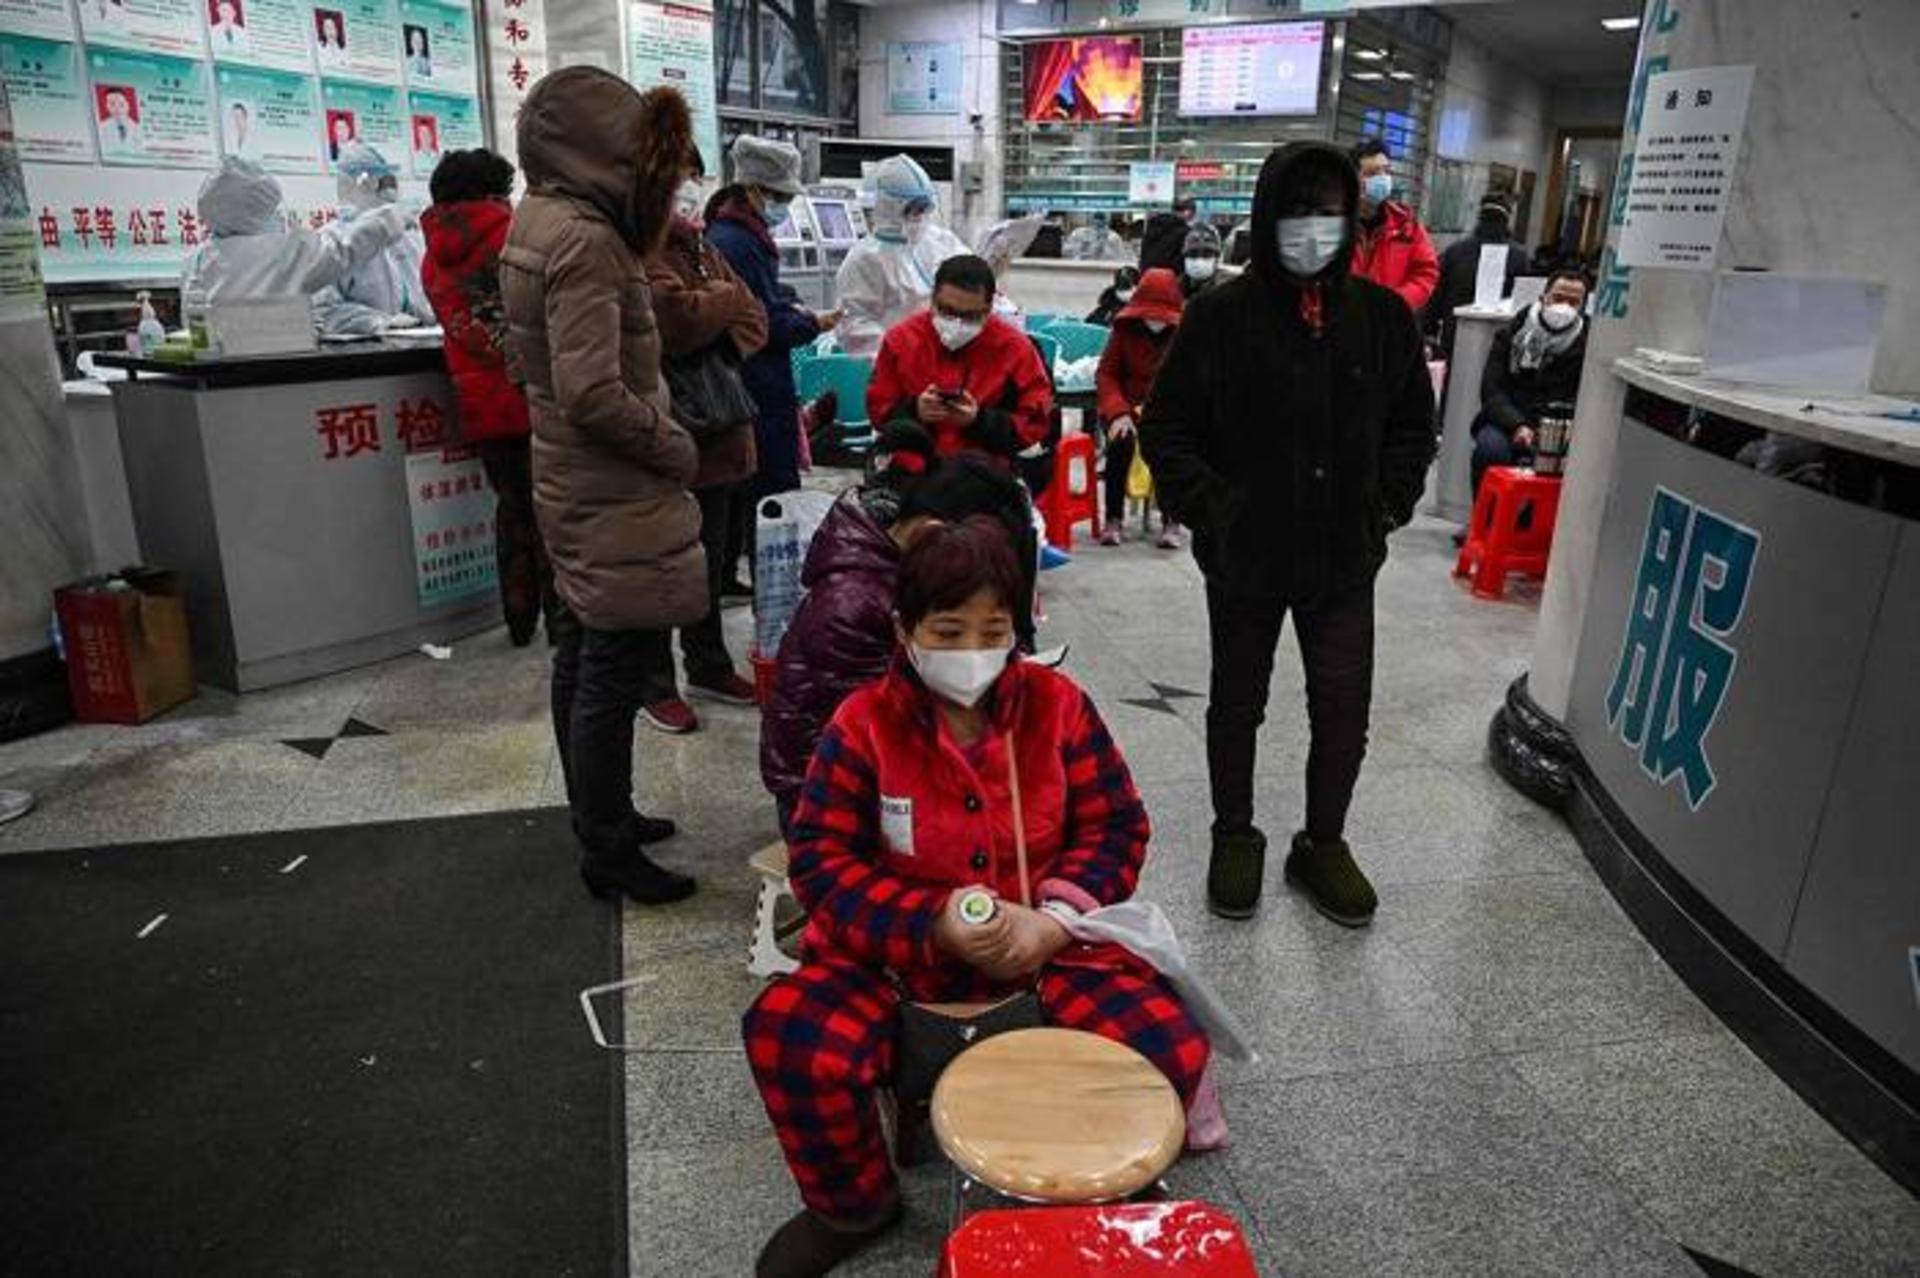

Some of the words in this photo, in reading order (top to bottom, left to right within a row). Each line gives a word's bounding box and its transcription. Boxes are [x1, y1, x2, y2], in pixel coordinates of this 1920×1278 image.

[72, 205, 117, 249] 平等
[127, 208, 169, 247] 公正
[1606, 484, 1761, 812] 服
